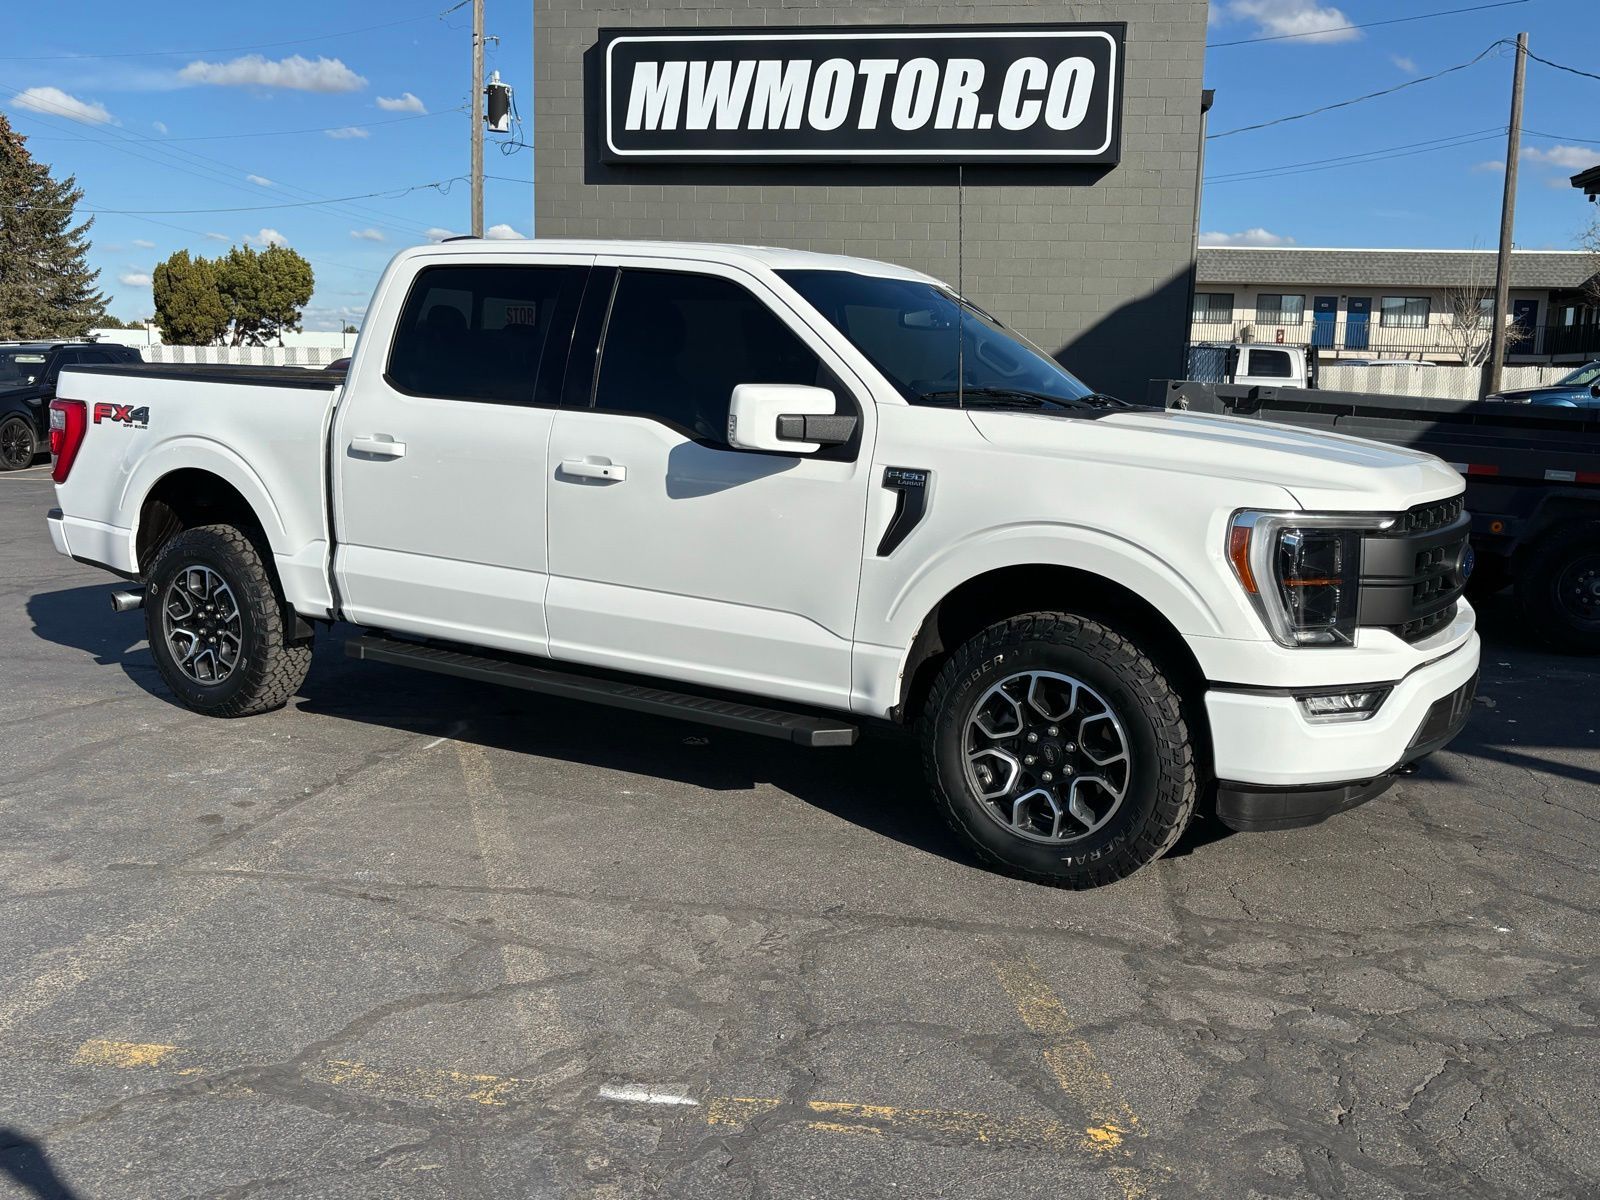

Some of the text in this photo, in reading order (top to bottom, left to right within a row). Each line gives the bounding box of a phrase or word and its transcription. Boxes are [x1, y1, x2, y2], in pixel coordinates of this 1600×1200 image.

[624, 56, 1096, 132] MWMOTOR.CO
[93, 402, 150, 425] FX4
[888, 471, 925, 481] F-150
